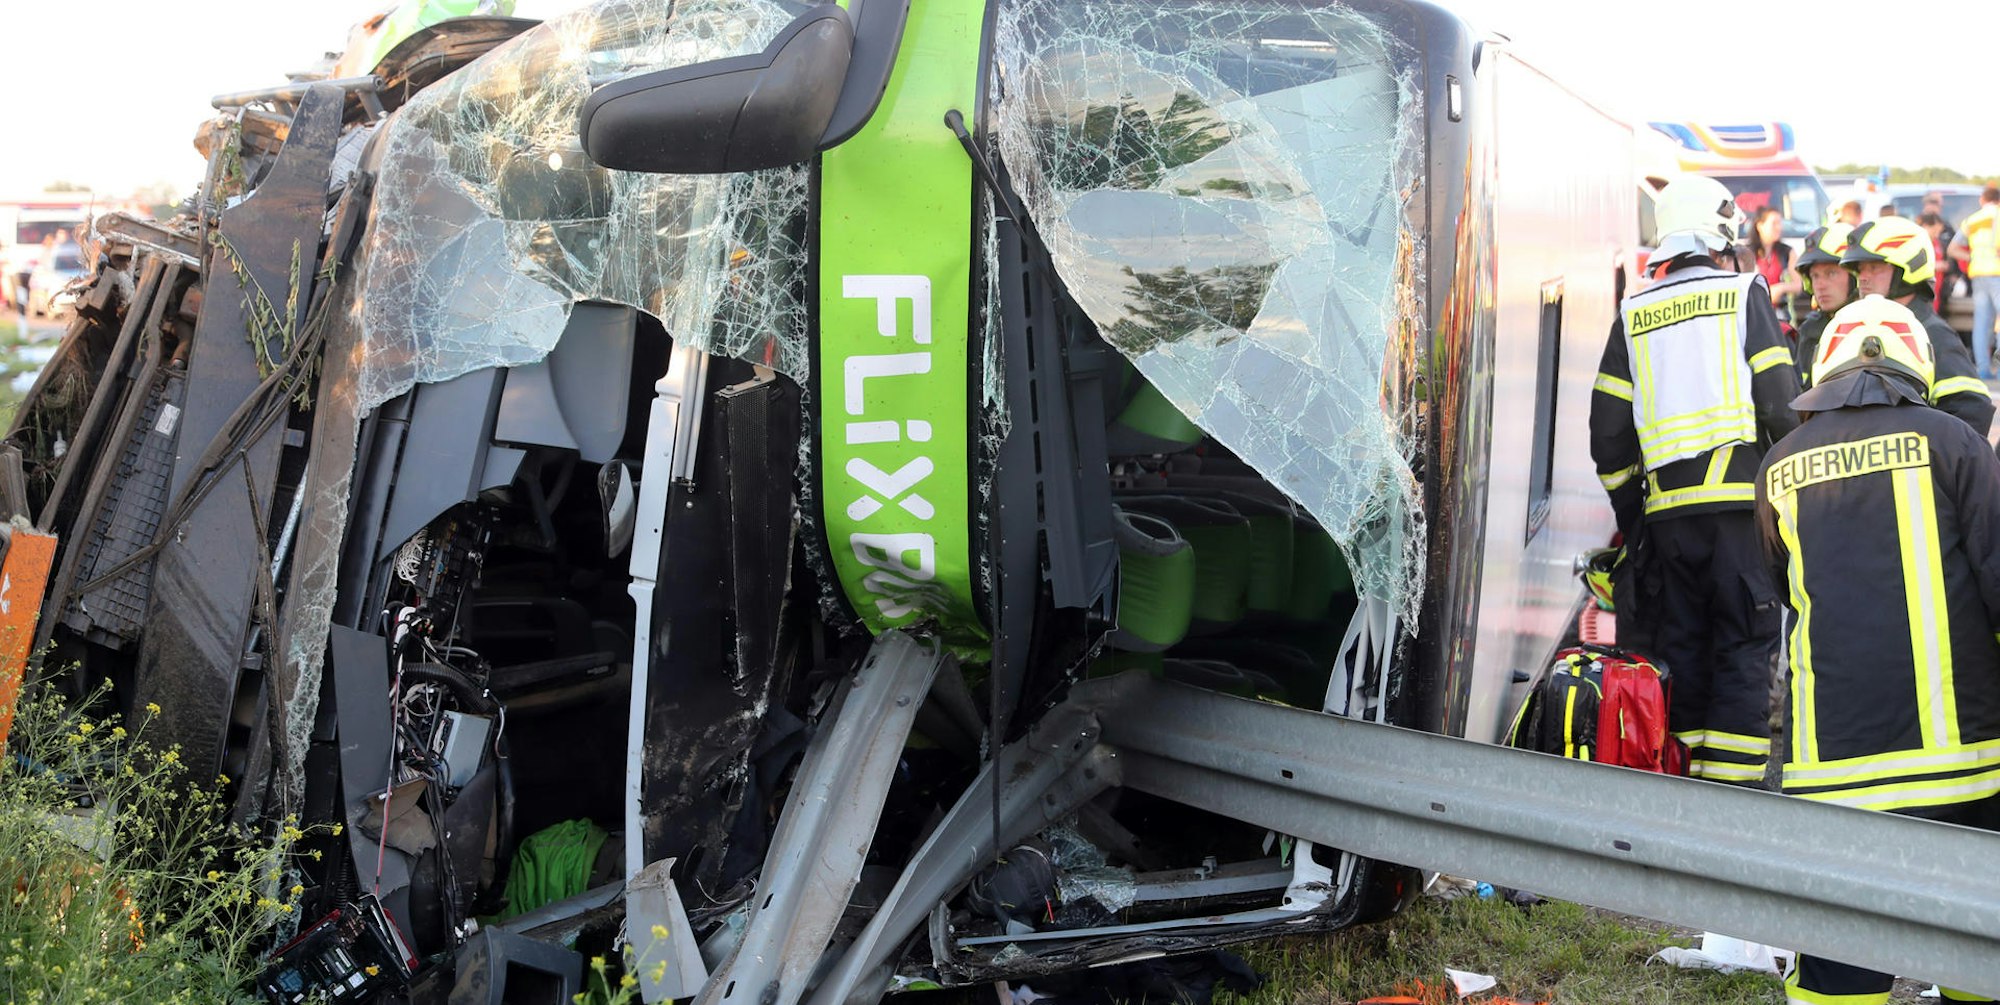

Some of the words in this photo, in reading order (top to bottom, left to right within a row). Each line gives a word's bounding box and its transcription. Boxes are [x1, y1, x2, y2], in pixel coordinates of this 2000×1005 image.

[1632, 294, 1709, 331] Abschnitt
[1717, 291, 1736, 310] III
[1770, 436, 1922, 496] FEUERWEHR
